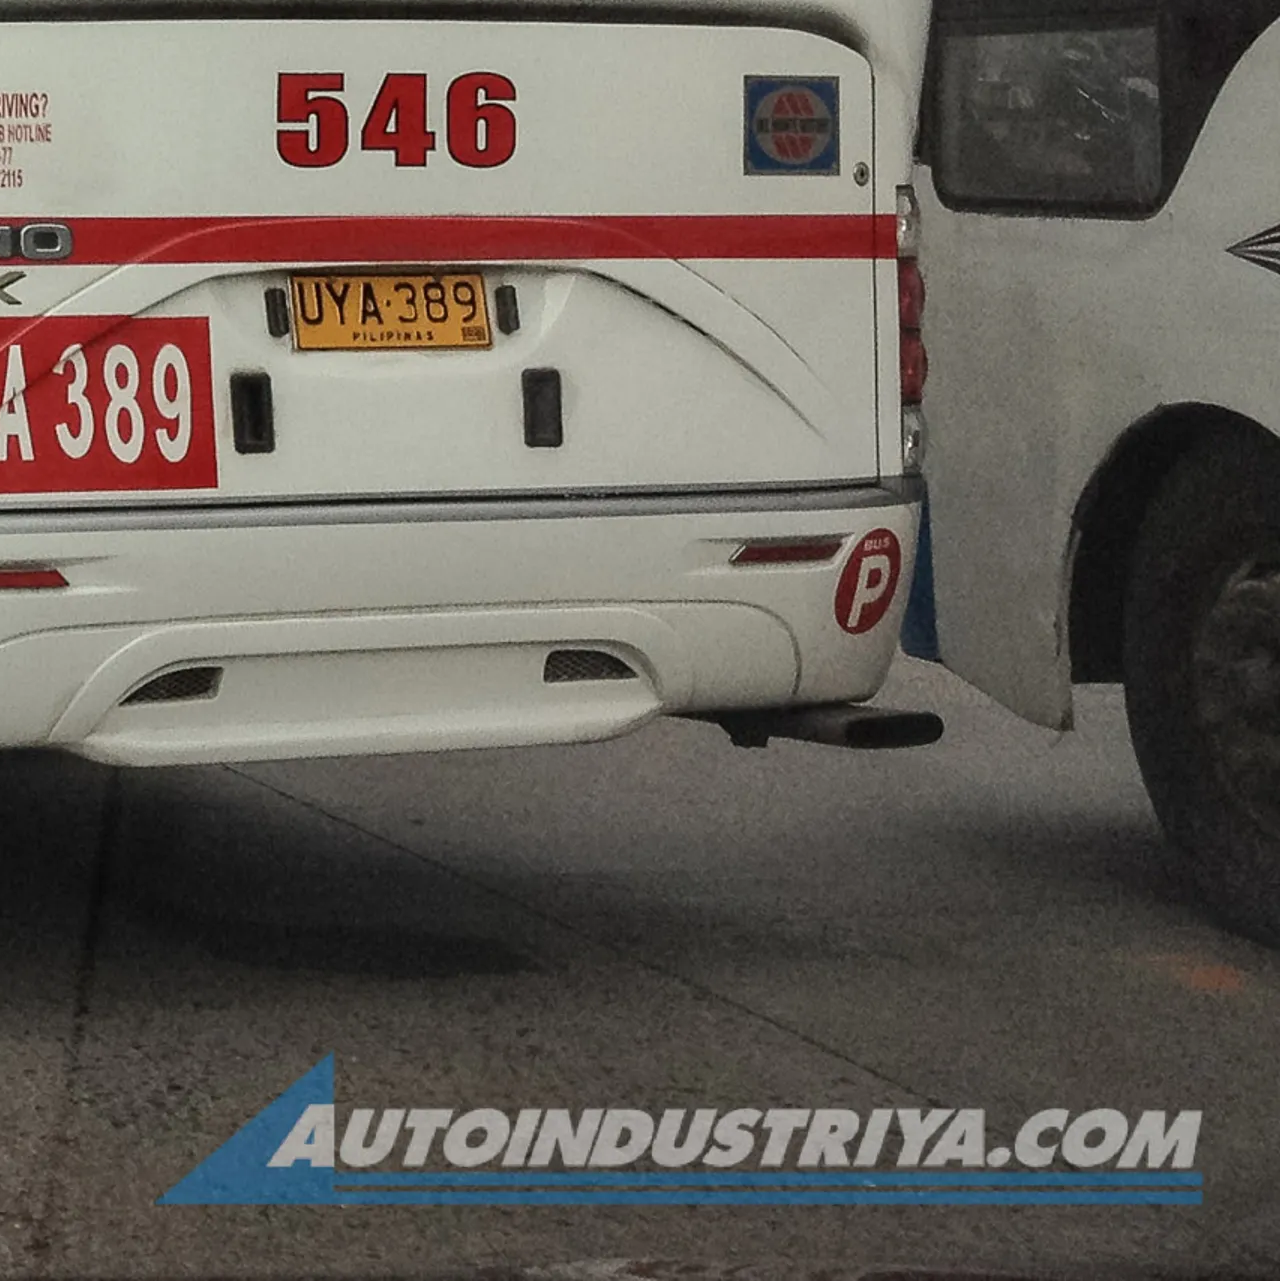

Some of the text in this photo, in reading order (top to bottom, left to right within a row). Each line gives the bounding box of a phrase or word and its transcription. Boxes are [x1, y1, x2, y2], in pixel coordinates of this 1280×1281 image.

[8, 124, 52, 142] HOTLINE
[276, 71, 517, 169] 546
[352, 330, 434, 342] PILIPINAS
[55, 343, 192, 464] 389
[864, 536, 891, 551] BUS
[846, 554, 891, 628] P
